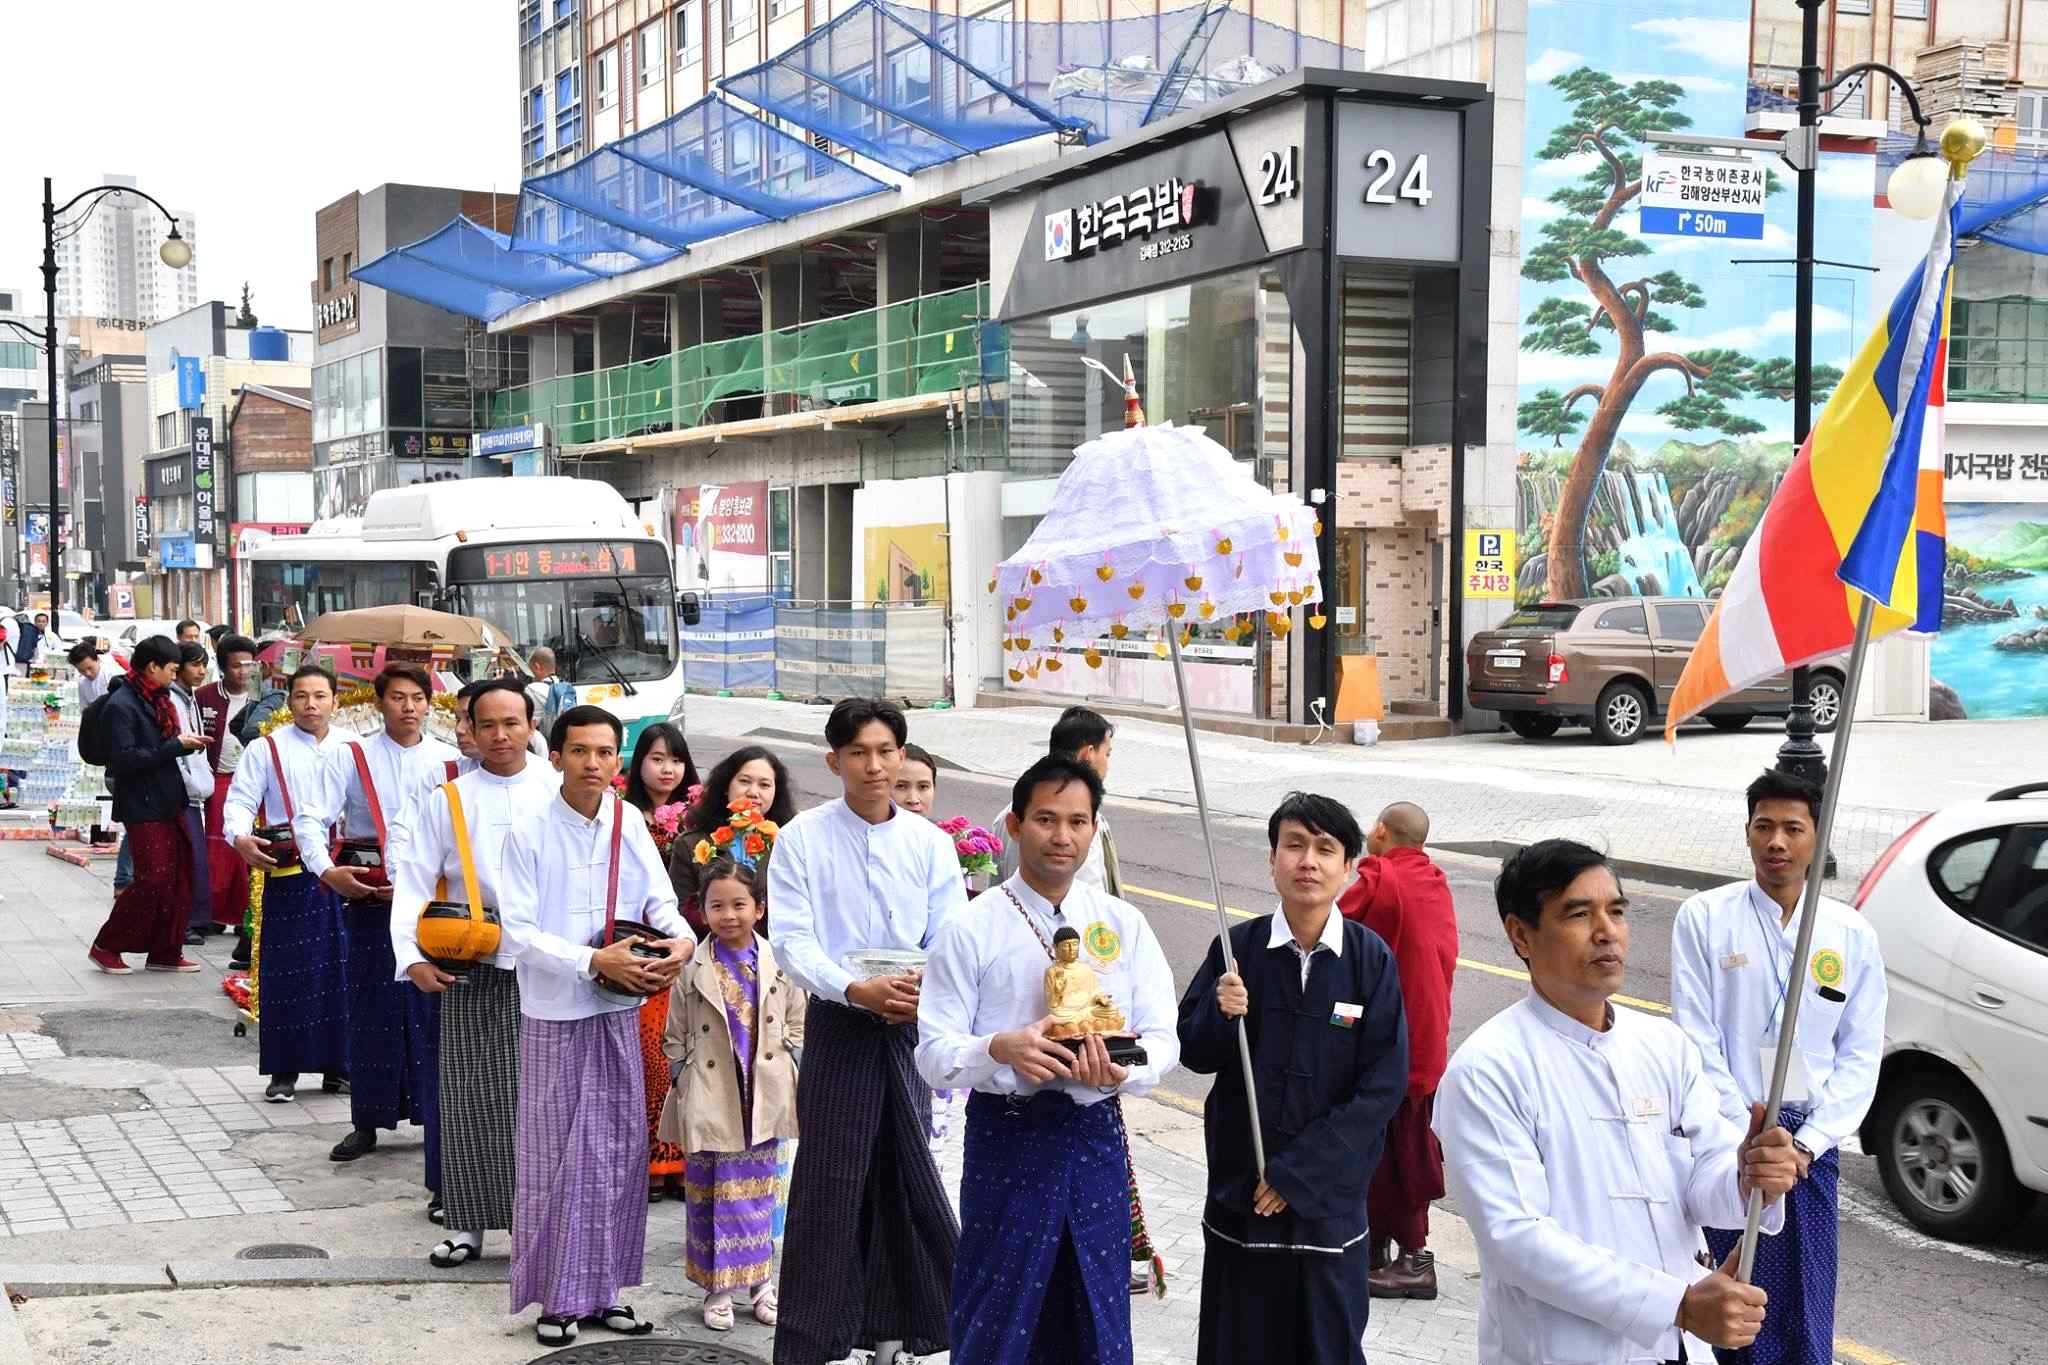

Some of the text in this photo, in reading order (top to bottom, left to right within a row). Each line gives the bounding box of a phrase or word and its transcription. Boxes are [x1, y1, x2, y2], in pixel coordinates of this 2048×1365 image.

[1257, 145, 1295, 206] 24
[1366, 149, 1432, 206] 24
[1681, 165, 1762, 186] 한국농어촌공사
[1681, 185, 1761, 205] 김해양산부산지사
[1077, 176, 1184, 251] 한국국밥
[1695, 213, 1727, 235] 50m
[1158, 234, 1191, 256] 312-2135
[1475, 560, 1503, 572] 한국
[1469, 575, 1510, 592] 주차장
